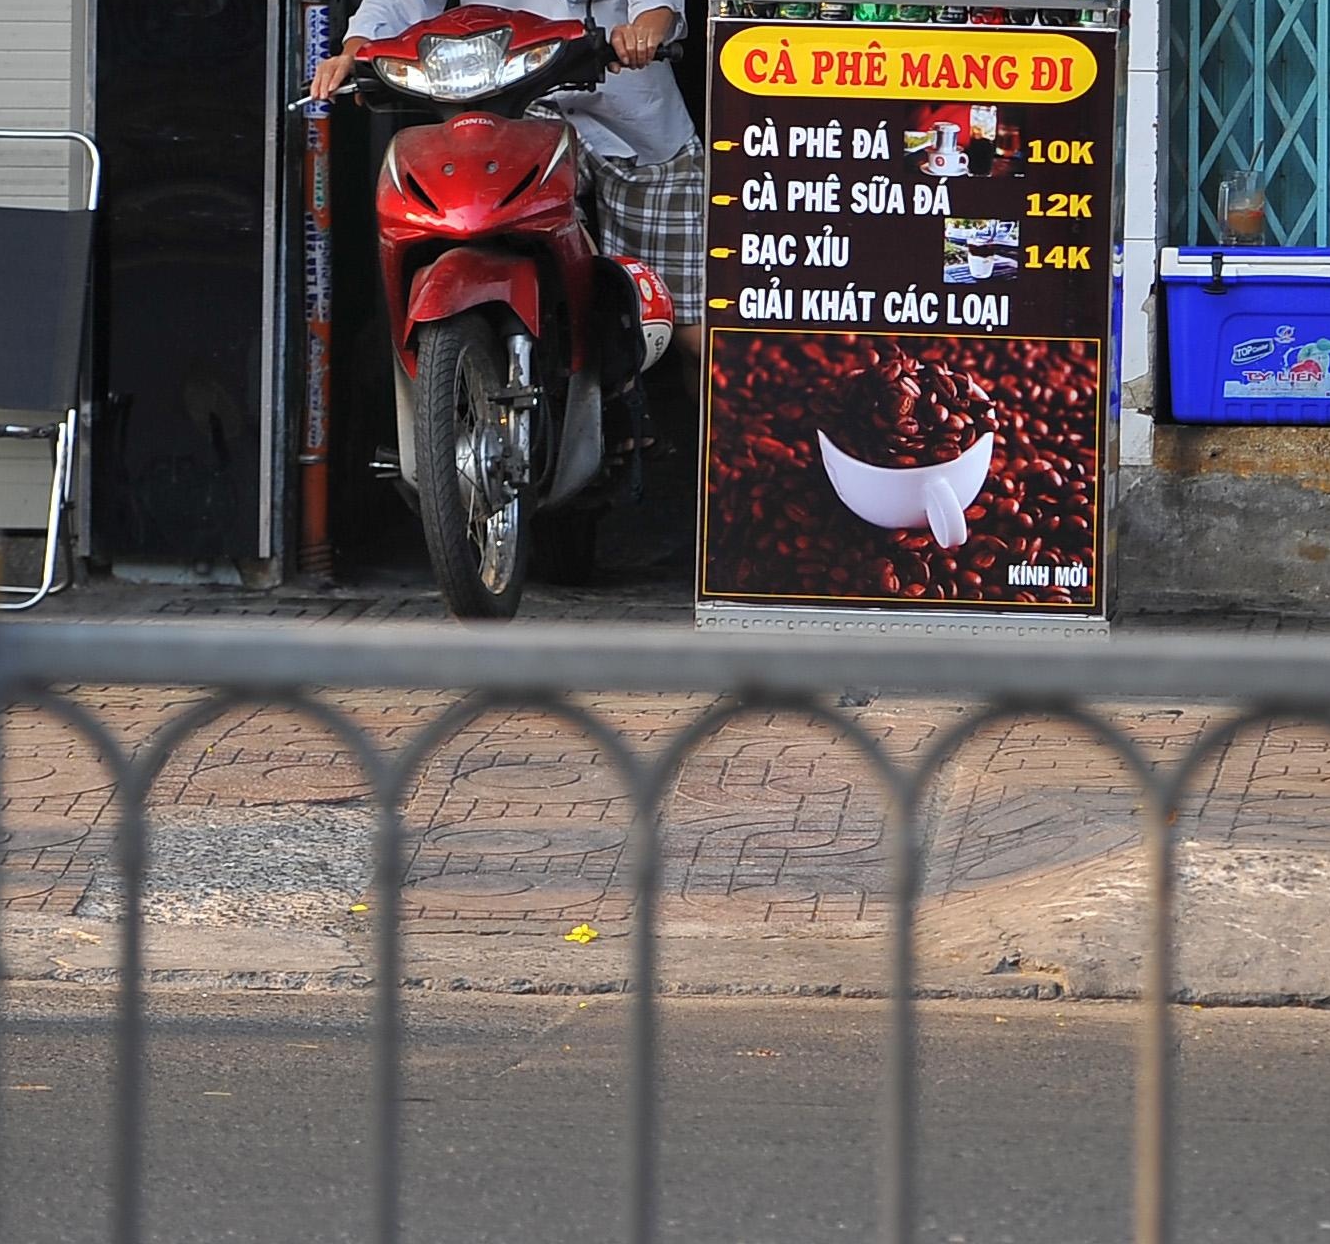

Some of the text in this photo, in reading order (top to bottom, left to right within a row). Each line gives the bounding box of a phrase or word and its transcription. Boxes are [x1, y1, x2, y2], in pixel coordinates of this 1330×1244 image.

[744, 39, 1074, 92] CÀ PHÊ MANG ĐI
[453, 118, 496, 130] HONDA
[743, 118, 1095, 165] CÀ PHÊ ĐÁ 10K
[742, 172, 1092, 218] CÀ PHÊ SỮA ĐÁ 12K
[741, 225, 1091, 272] BẠC XỈU 14K
[739, 276, 1009, 332] GIẢI KHÁT CÁC LOẠI
[1236, 345, 1253, 358] TOP
[1008, 560, 1088, 587] KÍNH MỜI
